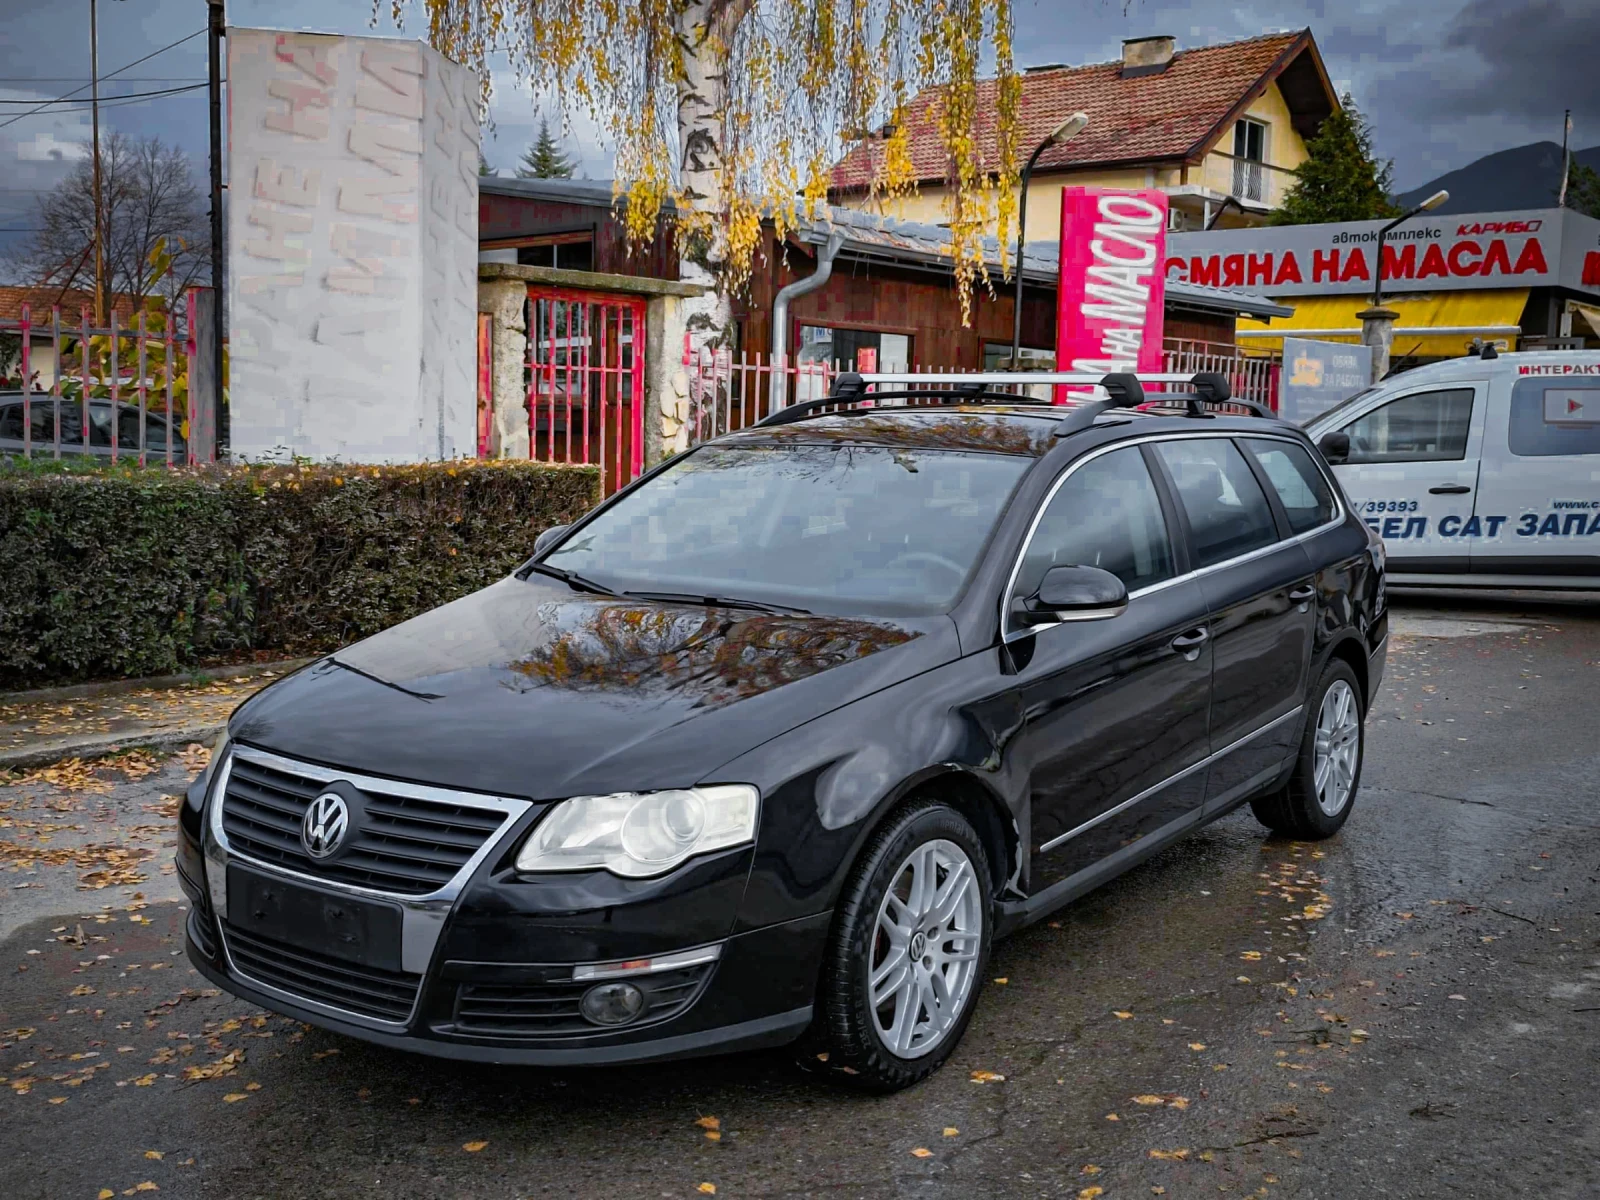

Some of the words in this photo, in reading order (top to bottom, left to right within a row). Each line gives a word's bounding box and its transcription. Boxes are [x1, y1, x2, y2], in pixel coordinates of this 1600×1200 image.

[1332, 227, 1441, 244] автокмплекс
[1456, 220, 1542, 236] КАРИБО
[1080, 195, 1163, 325] МАСЛО
[1165, 251, 1303, 287] СМЯНА
[1312, 247, 1370, 283] НА
[1380, 237, 1548, 280] МАСЛА
[1100, 328, 1143, 356] НА
[1438, 515, 1507, 537] САТ
